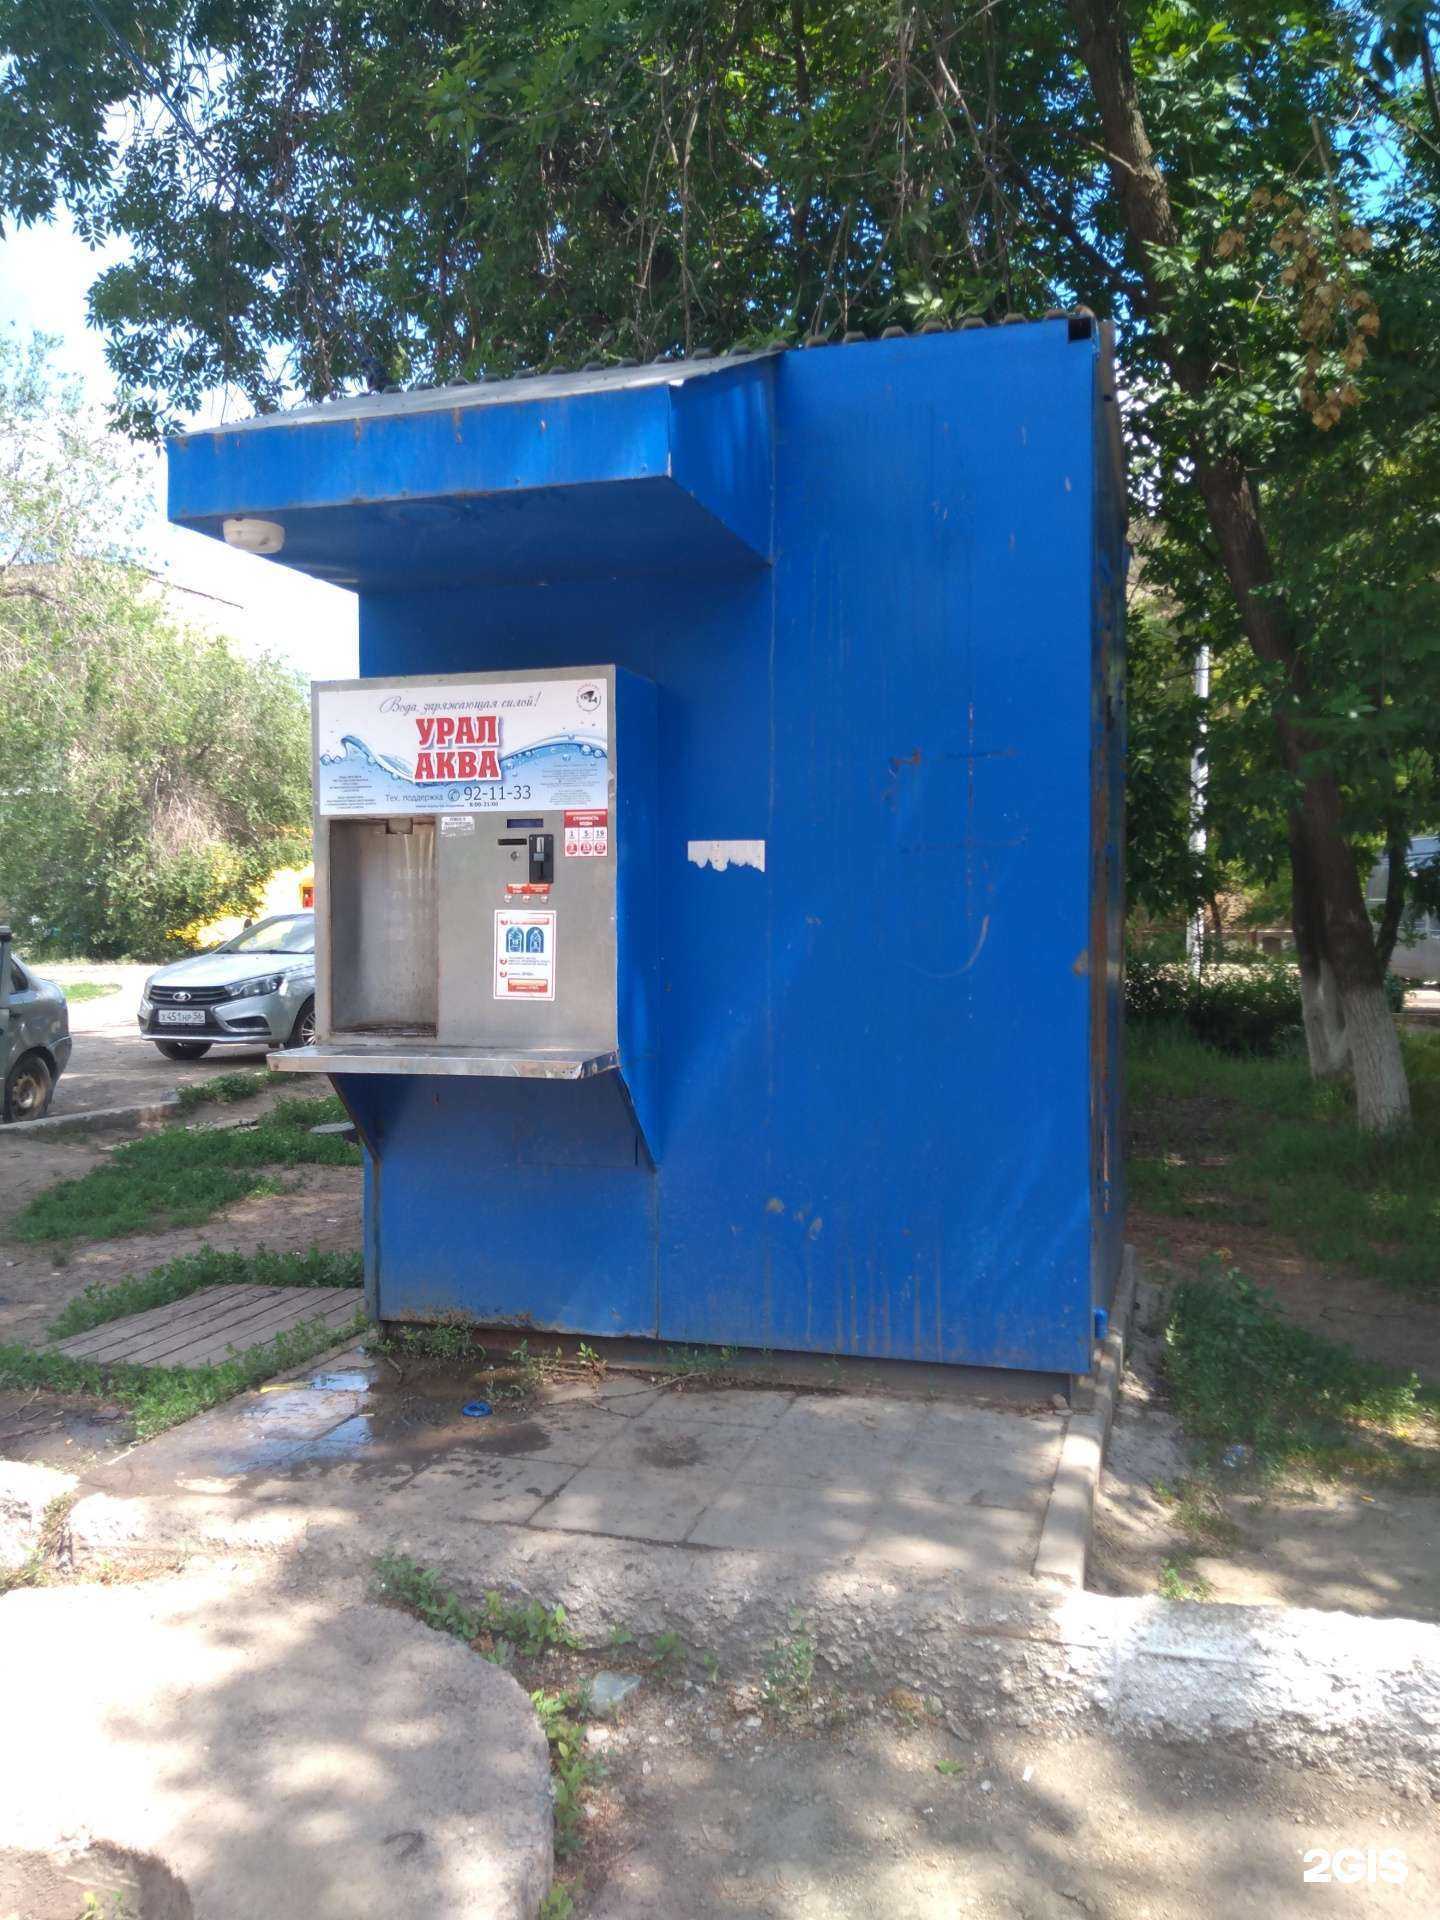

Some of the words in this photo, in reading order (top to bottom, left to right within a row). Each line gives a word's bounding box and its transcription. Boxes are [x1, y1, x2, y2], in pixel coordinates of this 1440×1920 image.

[501, 690, 542, 708] силой!
[414, 714, 500, 748] УРАЛ
[413, 748, 502, 781] АКВА
[402, 793, 443, 803] поддержка
[463, 784, 532, 801] 92-11-33
